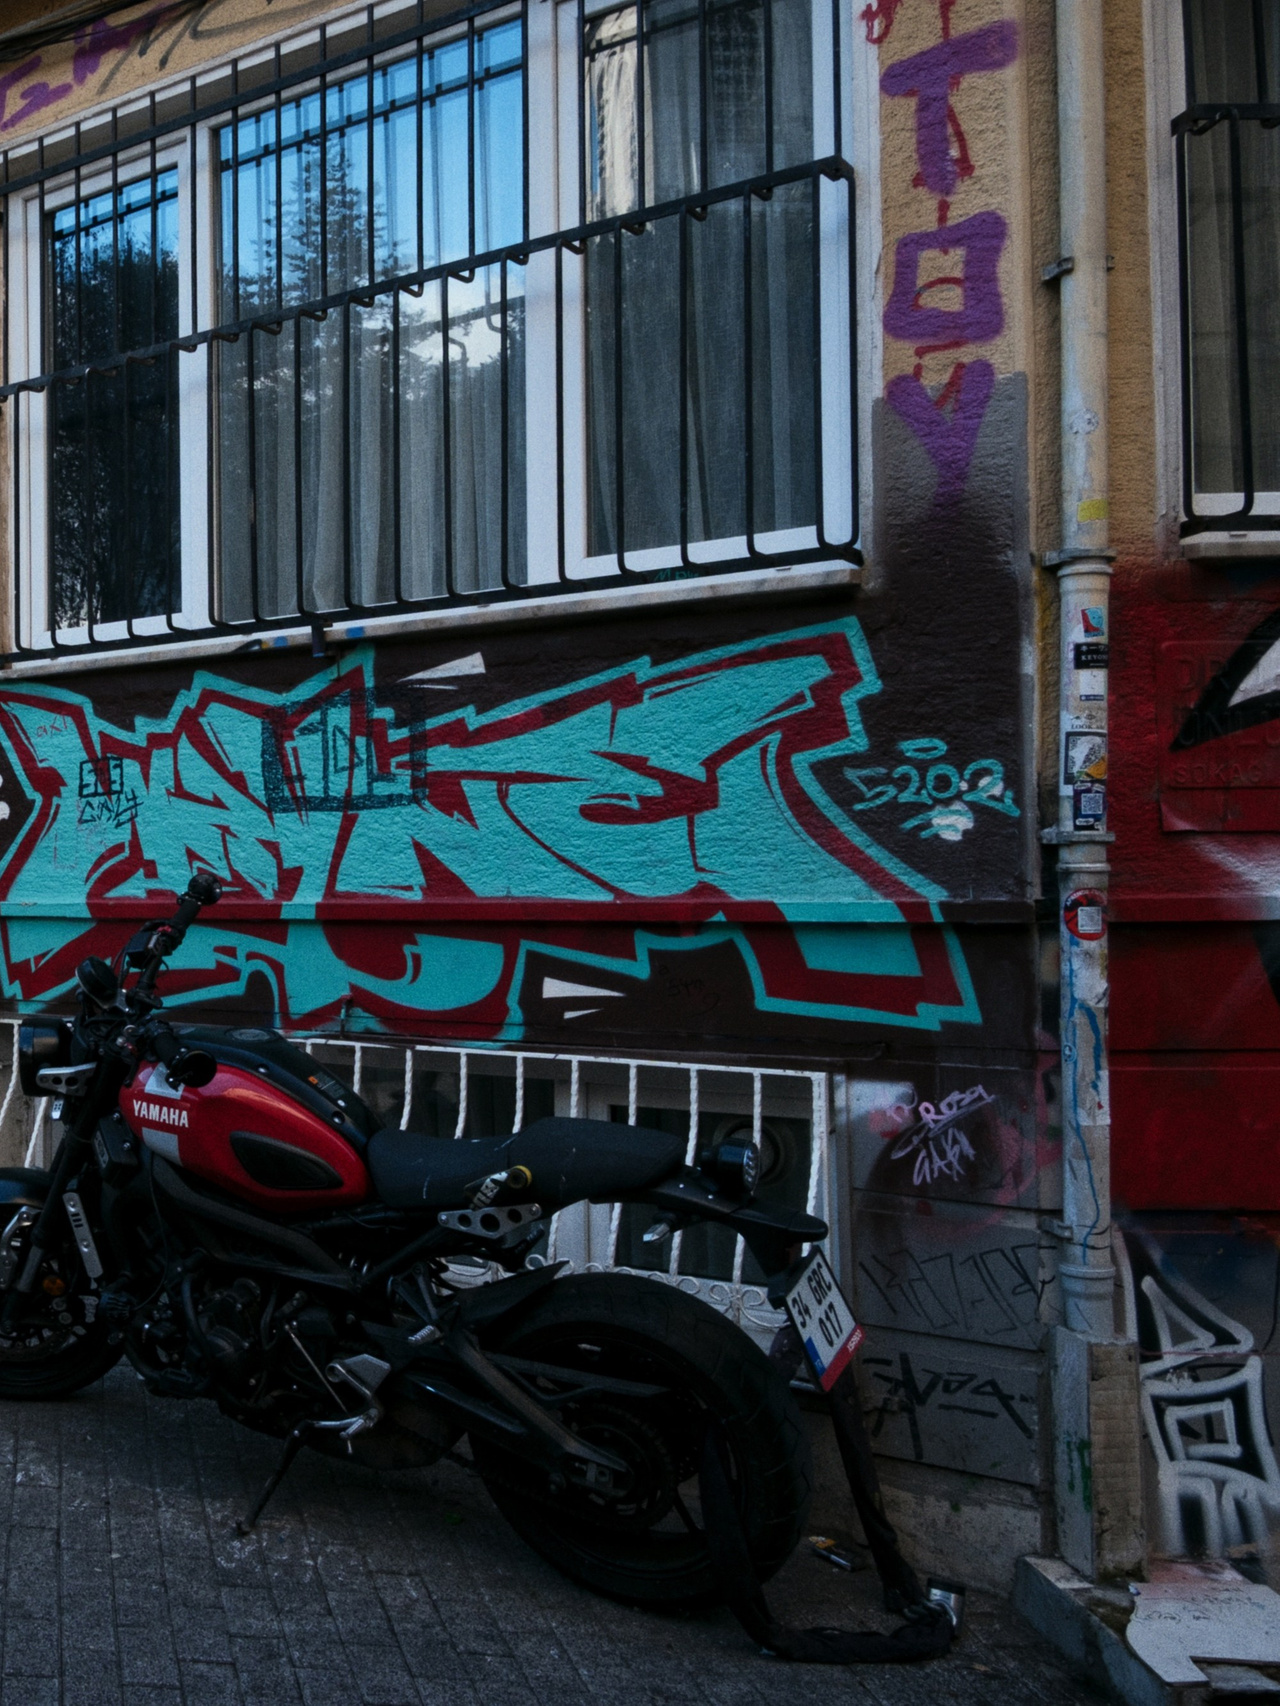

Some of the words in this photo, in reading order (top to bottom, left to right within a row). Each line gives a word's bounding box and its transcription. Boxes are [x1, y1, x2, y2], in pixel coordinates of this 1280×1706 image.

[132, 1098, 190, 1129] YAMAHA
[791, 1291, 813, 1330] 34
[806, 1261, 833, 1307] GRC
[818, 1301, 844, 1349] 017
